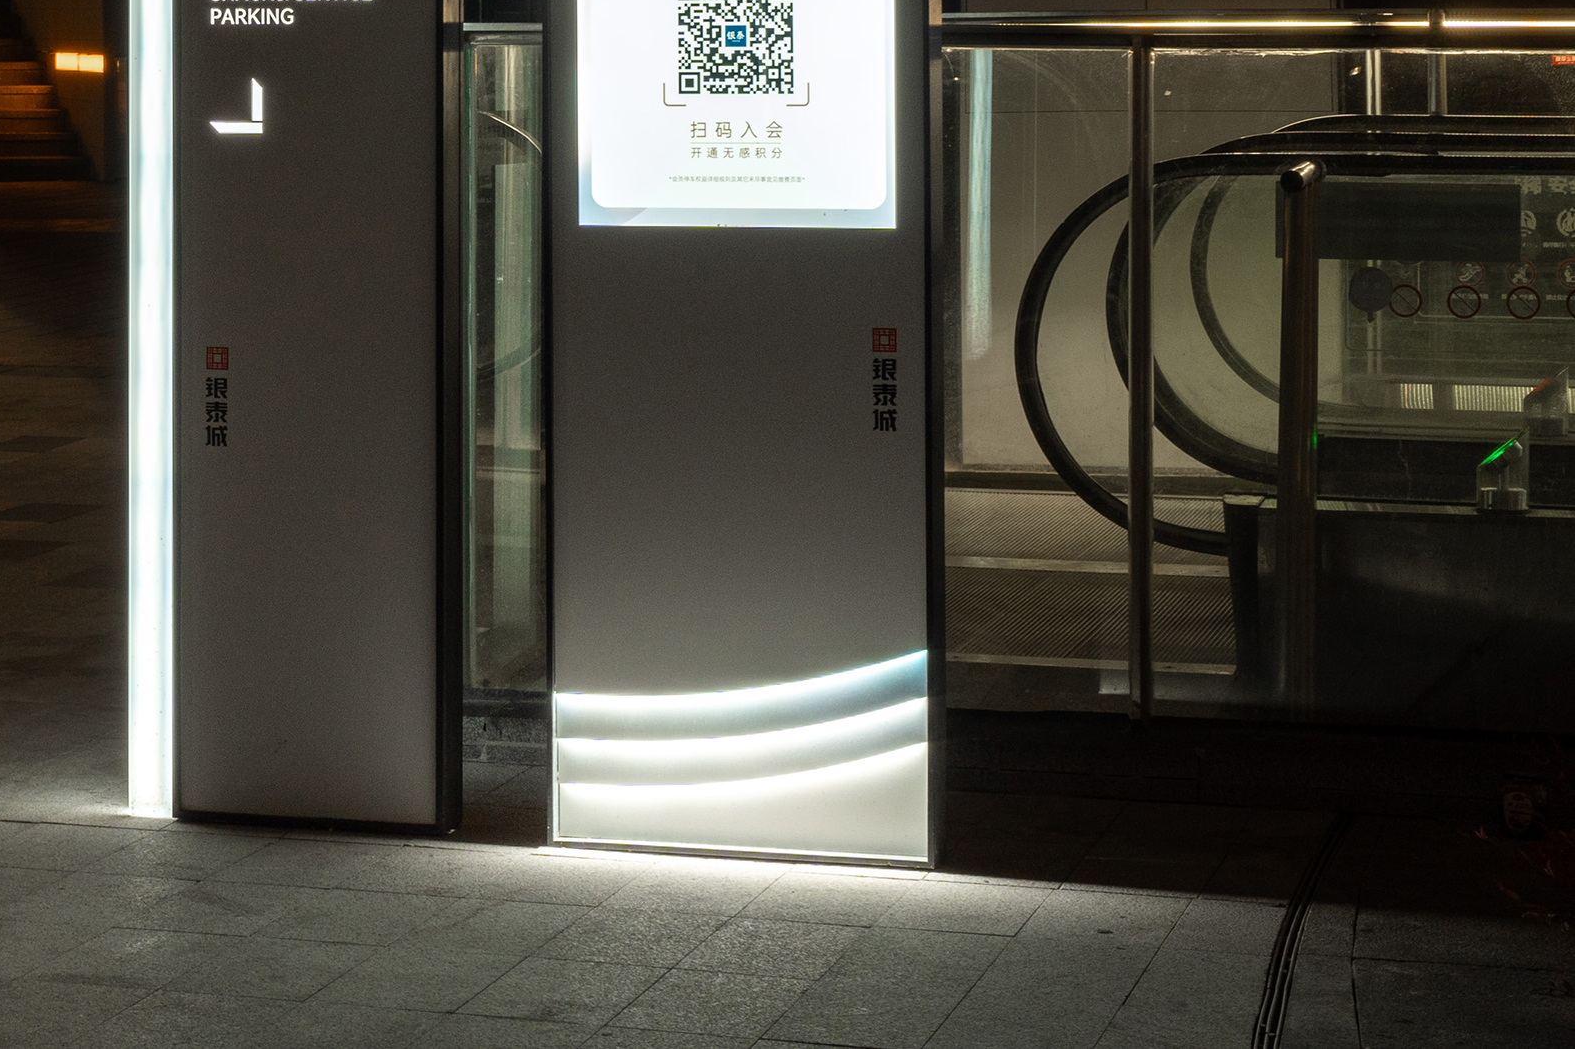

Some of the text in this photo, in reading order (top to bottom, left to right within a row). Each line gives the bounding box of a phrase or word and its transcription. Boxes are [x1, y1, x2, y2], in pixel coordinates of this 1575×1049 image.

[209, 7, 295, 26] PARKING
[690, 120, 783, 139] 扫码入会
[691, 147, 783, 159] 开通无感积分
[872, 358, 897, 431] 银泰城
[206, 377, 228, 447] 银泰城
